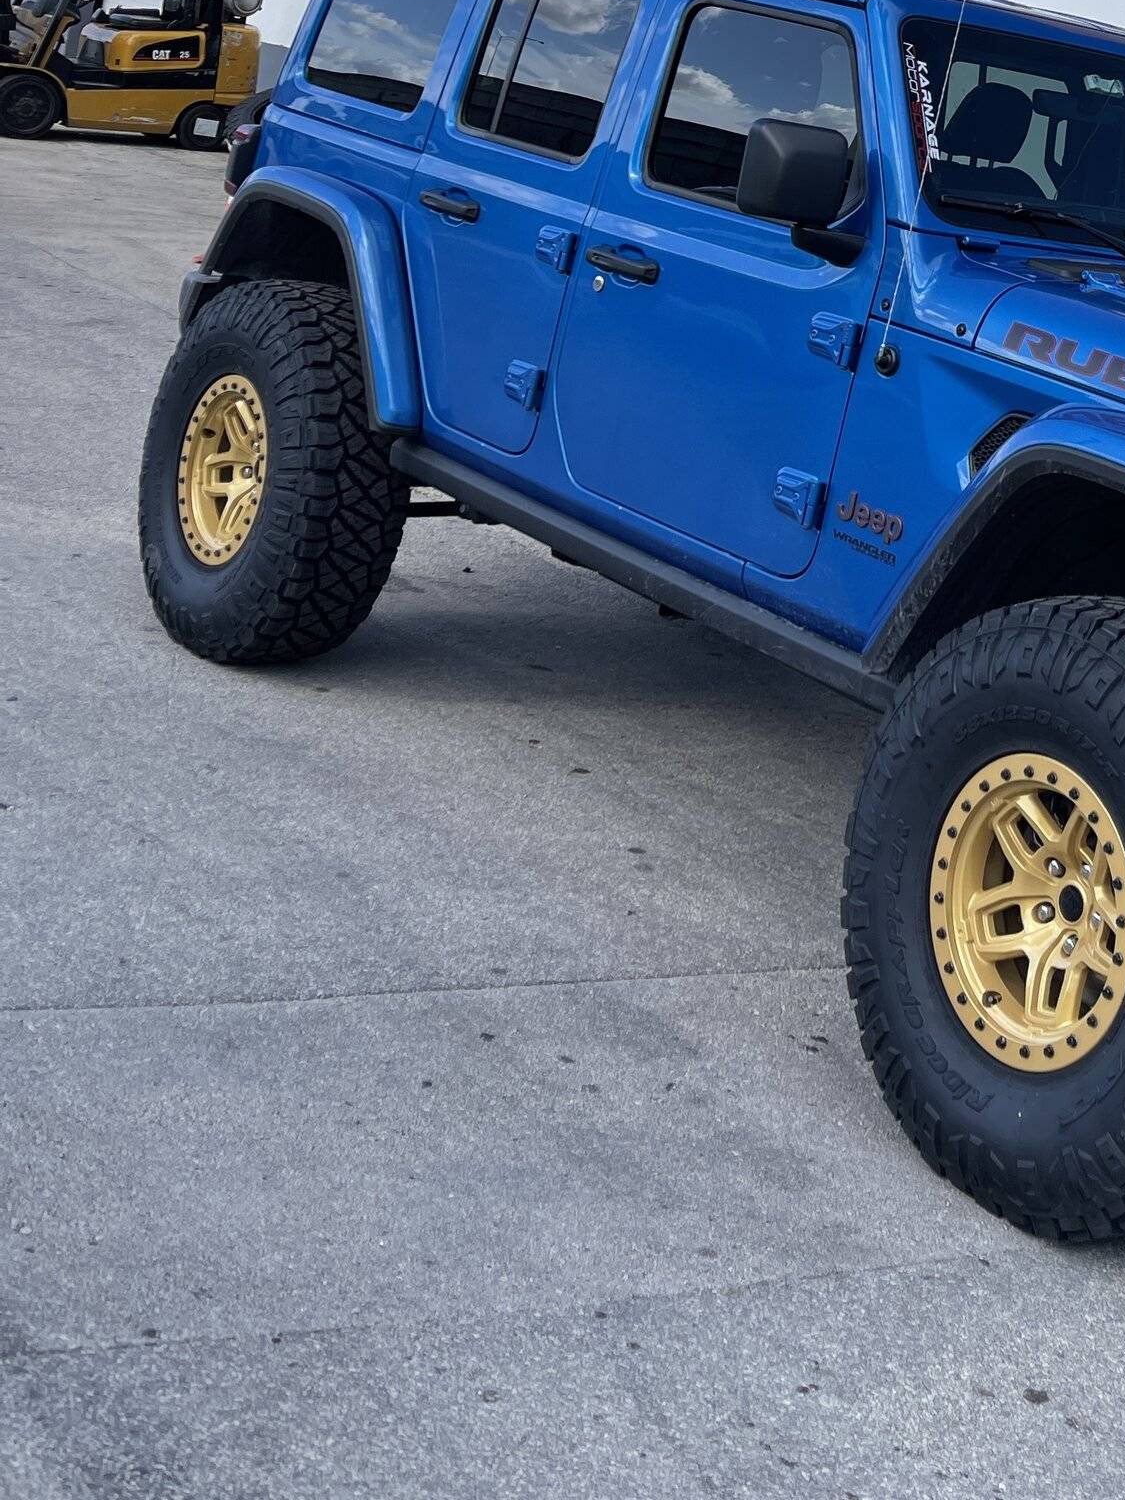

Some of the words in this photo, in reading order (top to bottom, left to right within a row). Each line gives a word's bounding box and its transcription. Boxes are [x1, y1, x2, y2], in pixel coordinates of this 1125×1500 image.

[152, 49, 171, 60] CAT
[179, 51, 190, 59] 25
[917, 60, 940, 161] KARNAGE
[836, 490, 903, 545] Jeep
[832, 528, 897, 563] WRANGLER
